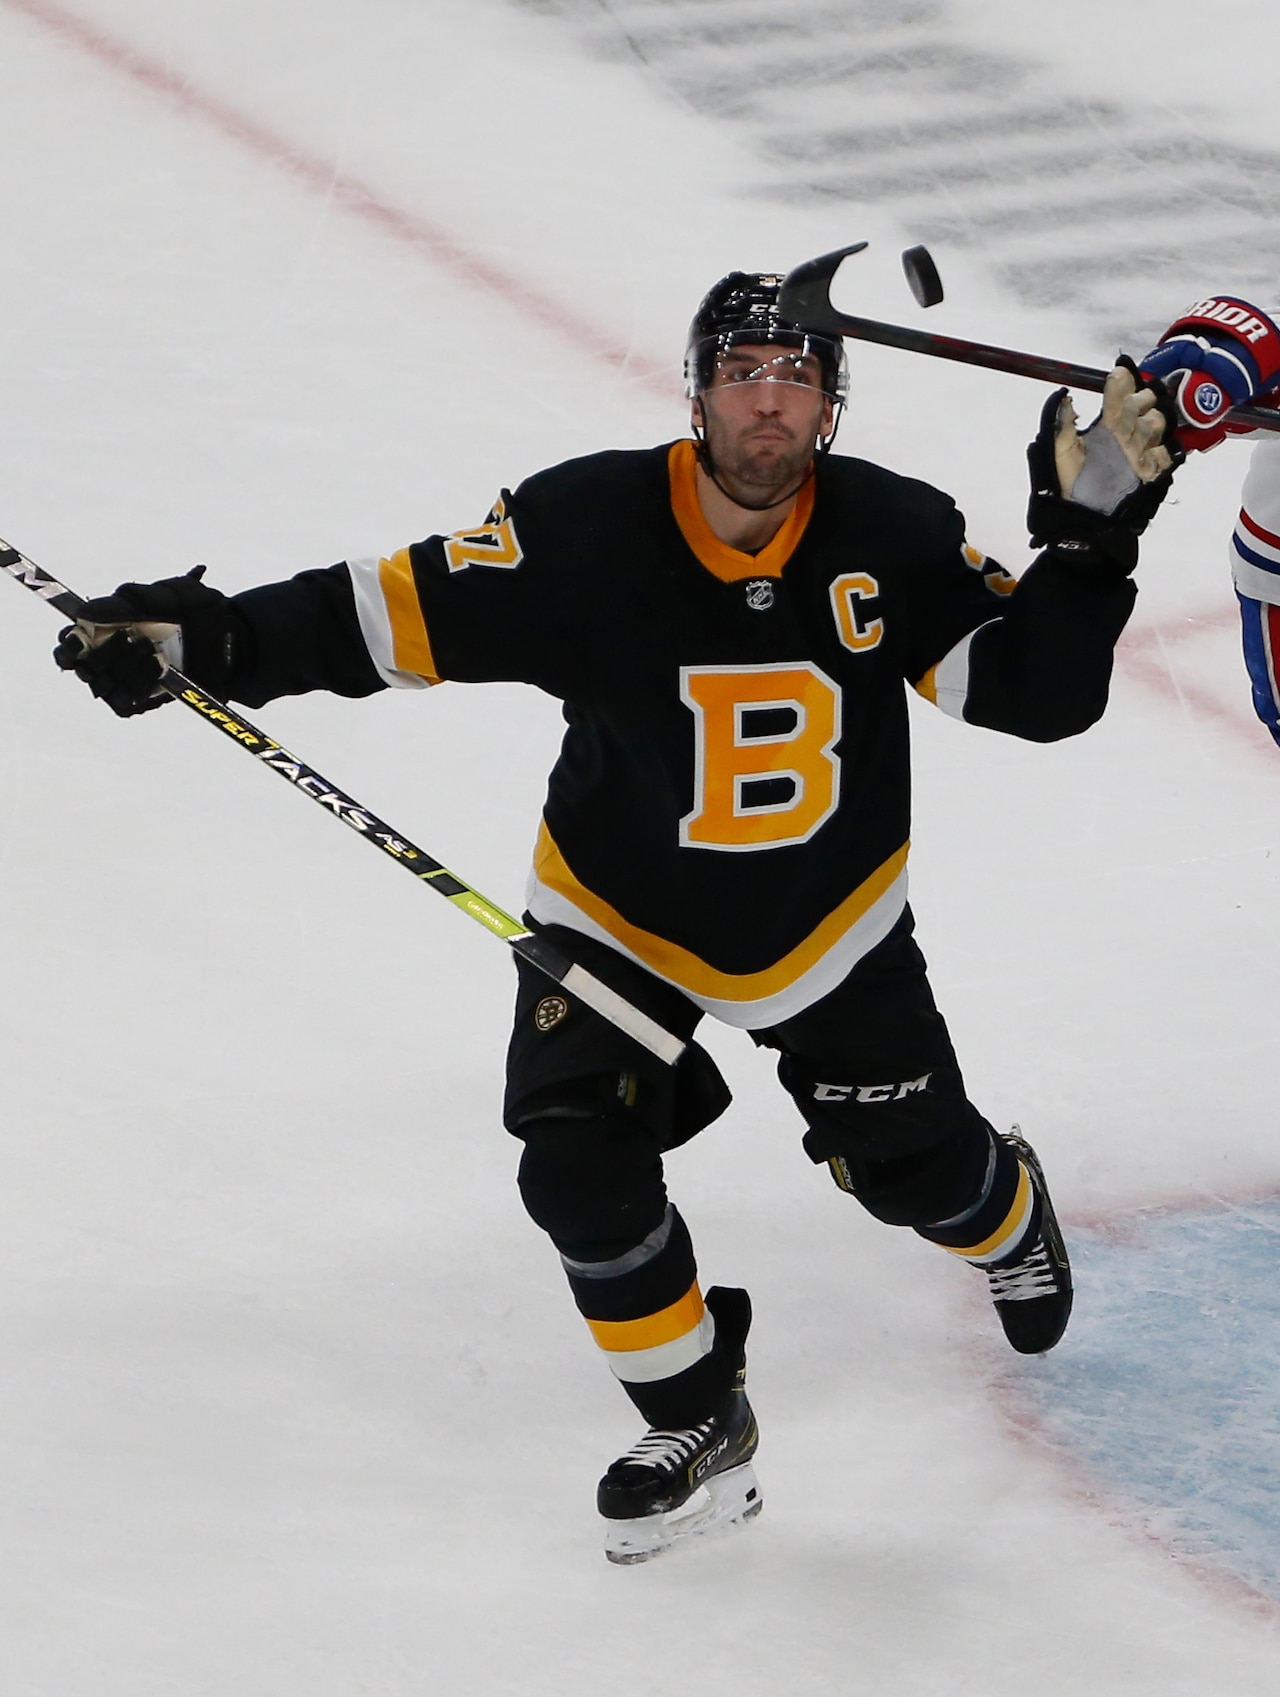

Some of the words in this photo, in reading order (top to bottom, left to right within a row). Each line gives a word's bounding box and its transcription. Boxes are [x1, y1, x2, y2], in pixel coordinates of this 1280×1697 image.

[749, 303, 780, 314] CC
[1183, 298, 1269, 344] RIOR
[829, 572, 884, 653] C
[182, 688, 260, 746] SUPER
[257, 736, 376, 832] TACKS
[679, 660, 843, 853] B
[813, 1072, 933, 1103] CCM
[696, 1437, 729, 1479] CCM
